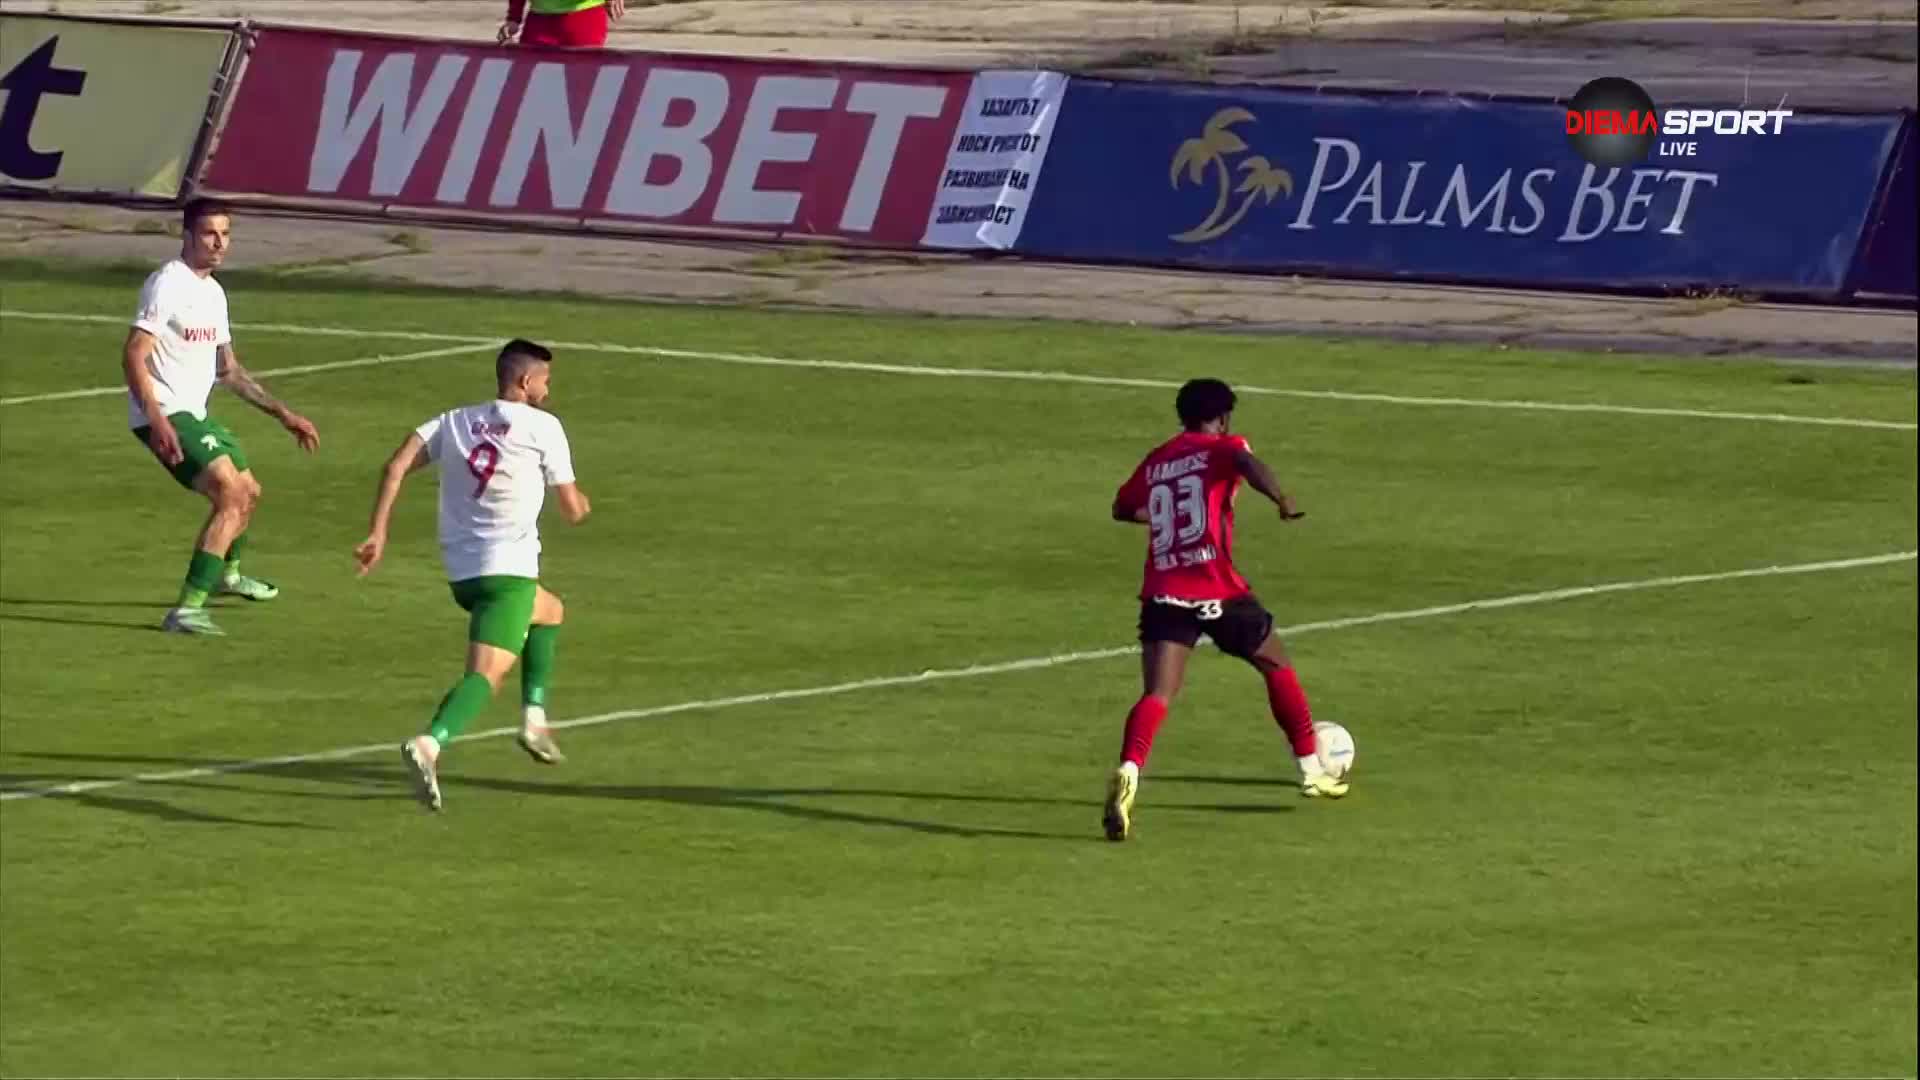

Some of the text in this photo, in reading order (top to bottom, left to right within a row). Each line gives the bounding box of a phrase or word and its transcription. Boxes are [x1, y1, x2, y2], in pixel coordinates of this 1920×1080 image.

[307, 49, 948, 232] WINBET
[1021, 133, 1040, 152] ОТ
[1288, 137, 1718, 242] PALMS BET
[469, 442, 498, 498] 9
[1149, 475, 1206, 553] 93
